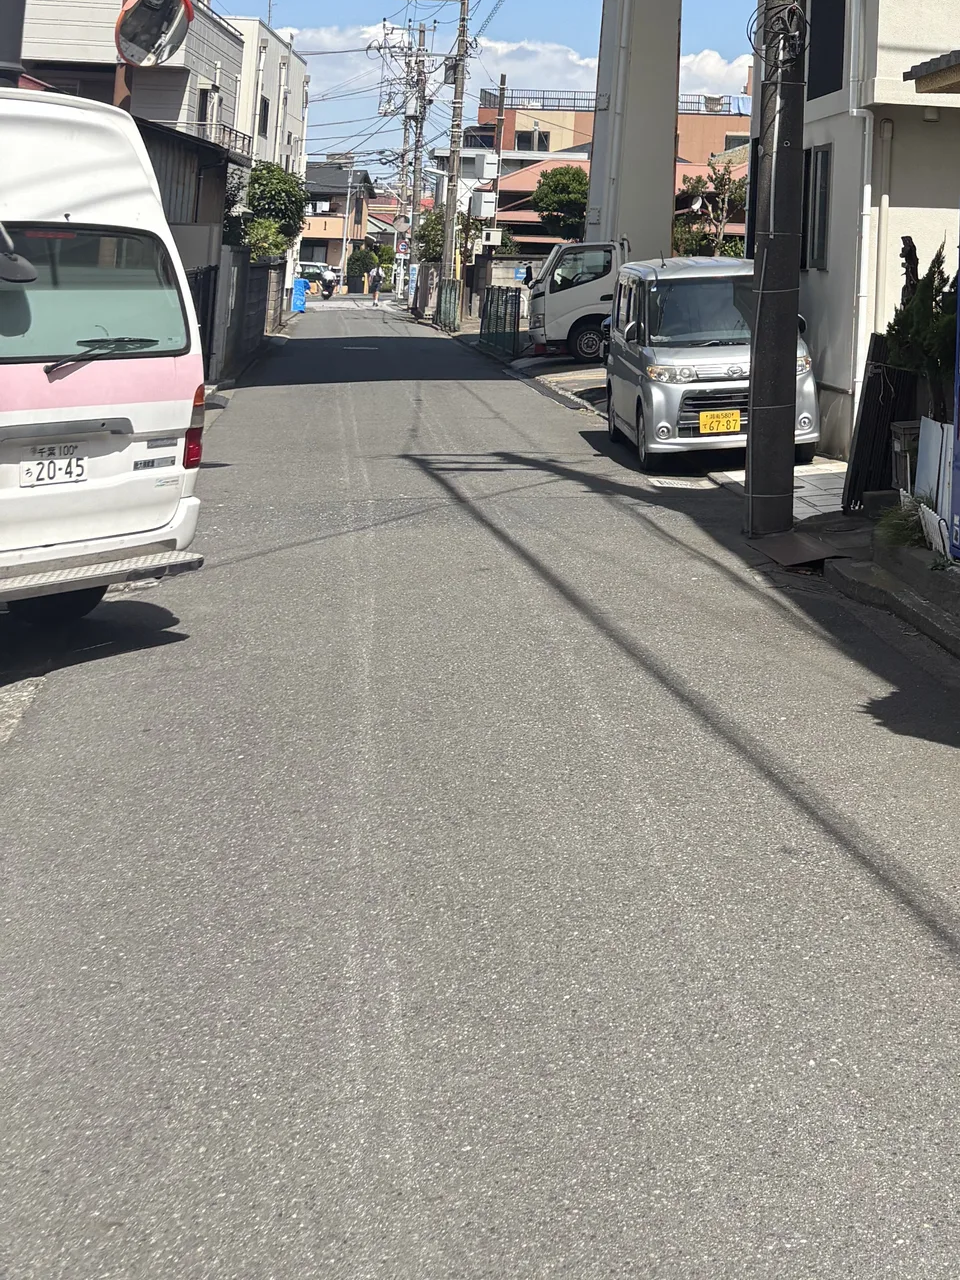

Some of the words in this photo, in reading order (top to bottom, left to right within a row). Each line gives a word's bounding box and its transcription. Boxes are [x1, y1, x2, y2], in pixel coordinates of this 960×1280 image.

[708, 419, 738, 431] 67-87
[37, 446, 56, 457] 千葉
[59, 445, 75, 456] 100
[36, 457, 84, 482] 20-45
